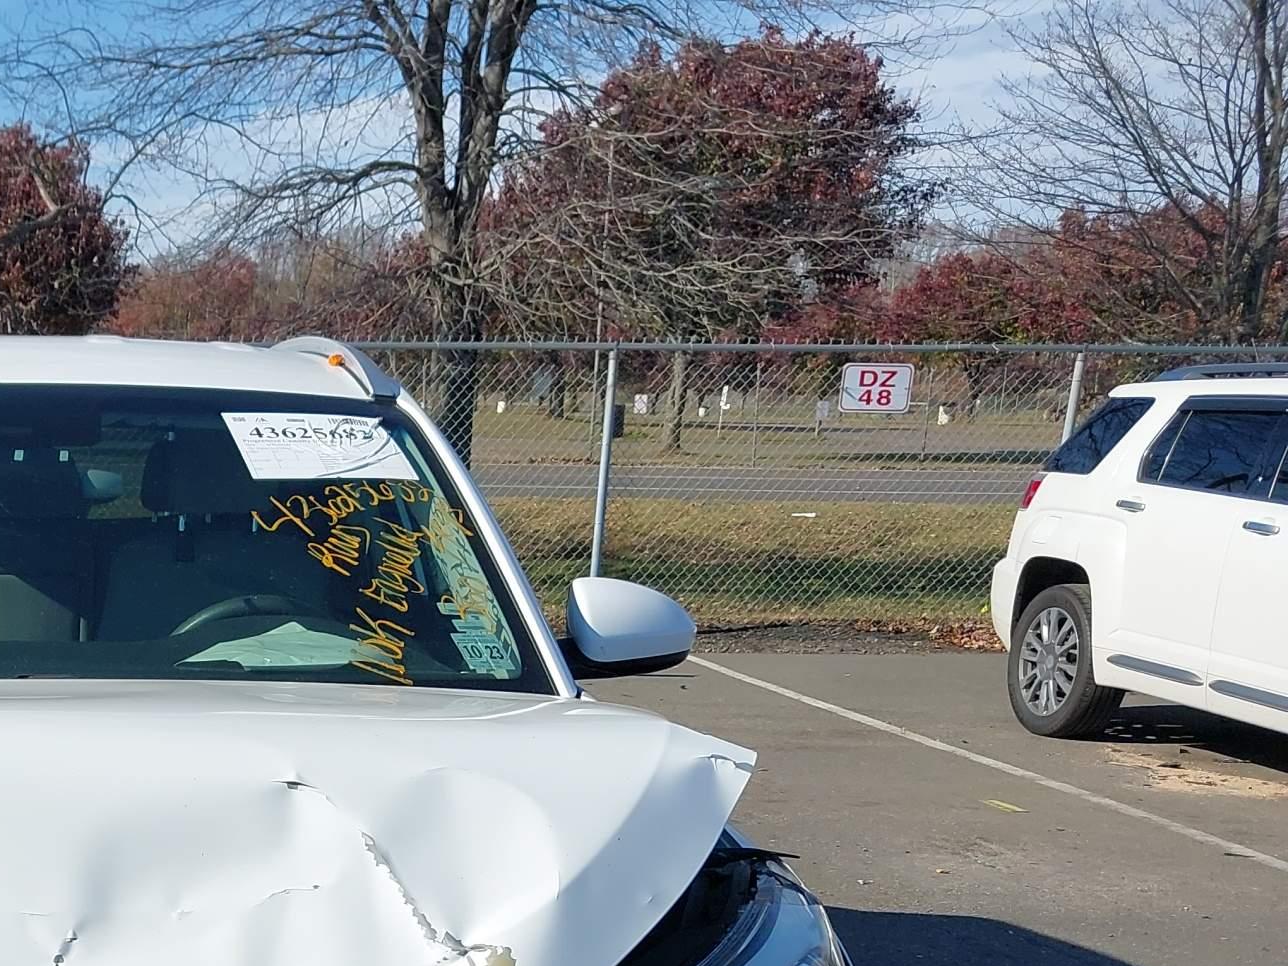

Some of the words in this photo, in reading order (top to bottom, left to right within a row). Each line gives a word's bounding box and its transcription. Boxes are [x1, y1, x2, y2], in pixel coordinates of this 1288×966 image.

[859, 370, 898, 388] DZ
[858, 389, 892, 406] 48
[463, 645, 483, 659] 10
[485, 645, 504, 660] 23
